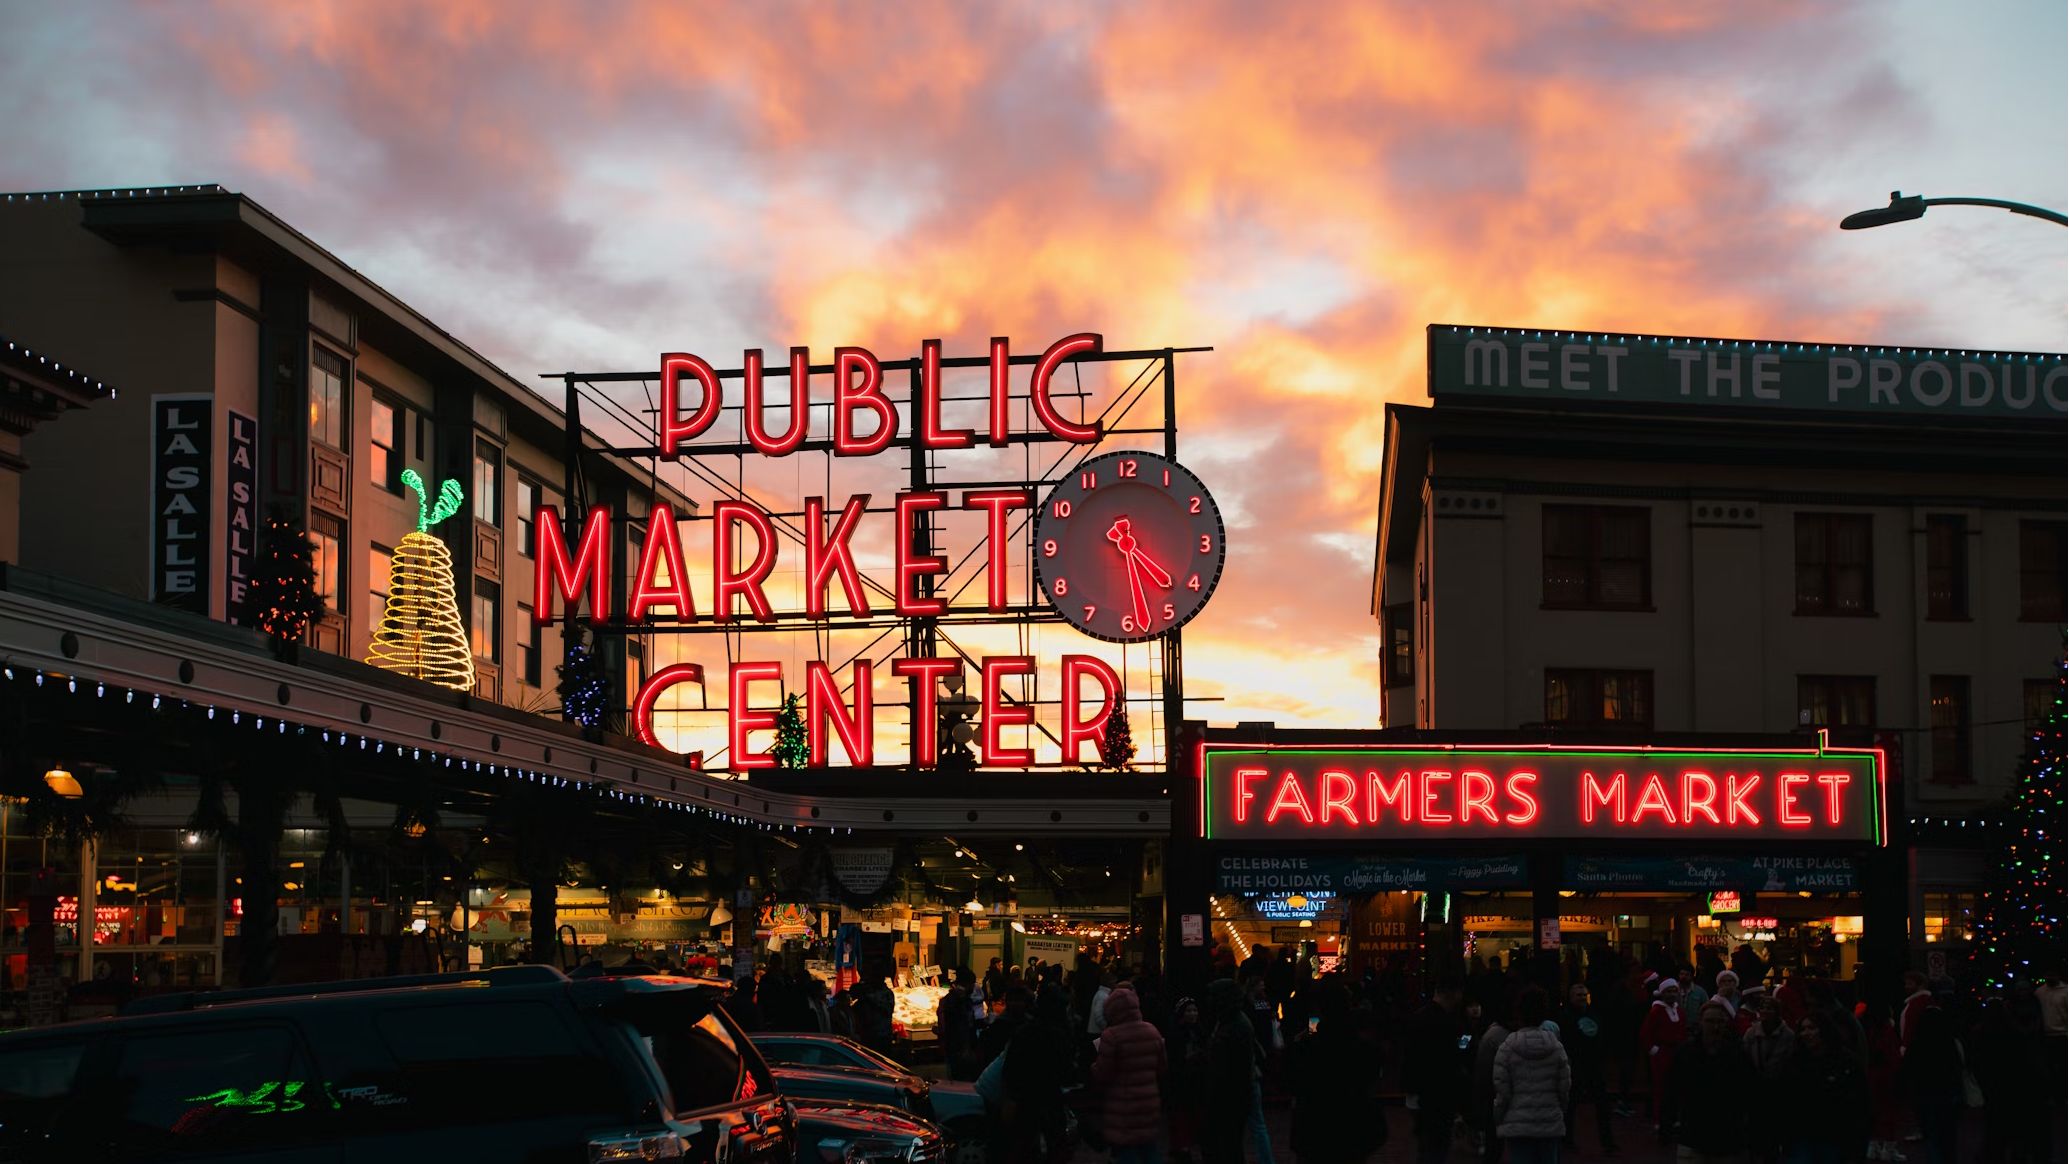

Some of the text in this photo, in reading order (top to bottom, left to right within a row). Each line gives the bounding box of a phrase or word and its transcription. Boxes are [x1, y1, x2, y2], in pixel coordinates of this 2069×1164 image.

[1463, 338, 2067, 413] MEET THE PRODUC
[660, 332, 1103, 462] PUBLIC
[232, 418, 251, 470] LA
[1118, 459, 1138, 478] 12
[1081, 472, 1097, 490] 11
[1163, 469, 1170, 487] 1
[162, 407, 200, 593] LA SALLE
[1189, 496, 1201, 514] 2
[1053, 501, 1072, 518] 10
[231, 481, 250, 604] SALLE
[1043, 539, 1057, 557] 9
[1199, 535, 1211, 553] 3
[533, 489, 1035, 626] MARKET
[1054, 577, 1067, 596] 8
[1187, 574, 1201, 592] 4
[1083, 605, 1096, 622] 7
[1163, 603, 1175, 621] 5
[1121, 615, 1135, 633] 6
[632, 654, 1123, 772] CENTER
[1235, 769, 1850, 825] FARMERS MARKET
[1221, 857, 1309, 870] CELEBRATE
[1483, 863, 1519, 876] Pudding
[1753, 857, 1769, 869] AT
[1773, 857, 1804, 869] PIKE
[1807, 857, 1851, 869] PLACE
[1221, 874, 1331, 888] THE HOLIDAYS
[1343, 868, 1426, 889] Magic in the Market
[1577, 872, 1644, 882] Santa Photos
[1796, 874, 1853, 886] MARKET
[1711, 899, 1740, 910] GROCERY
[1368, 922, 1406, 936] LOWER
[1559, 916, 1607, 926] AKERY
[1358, 941, 1416, 951] MARKET
[338, 1085, 379, 1101] TRD
